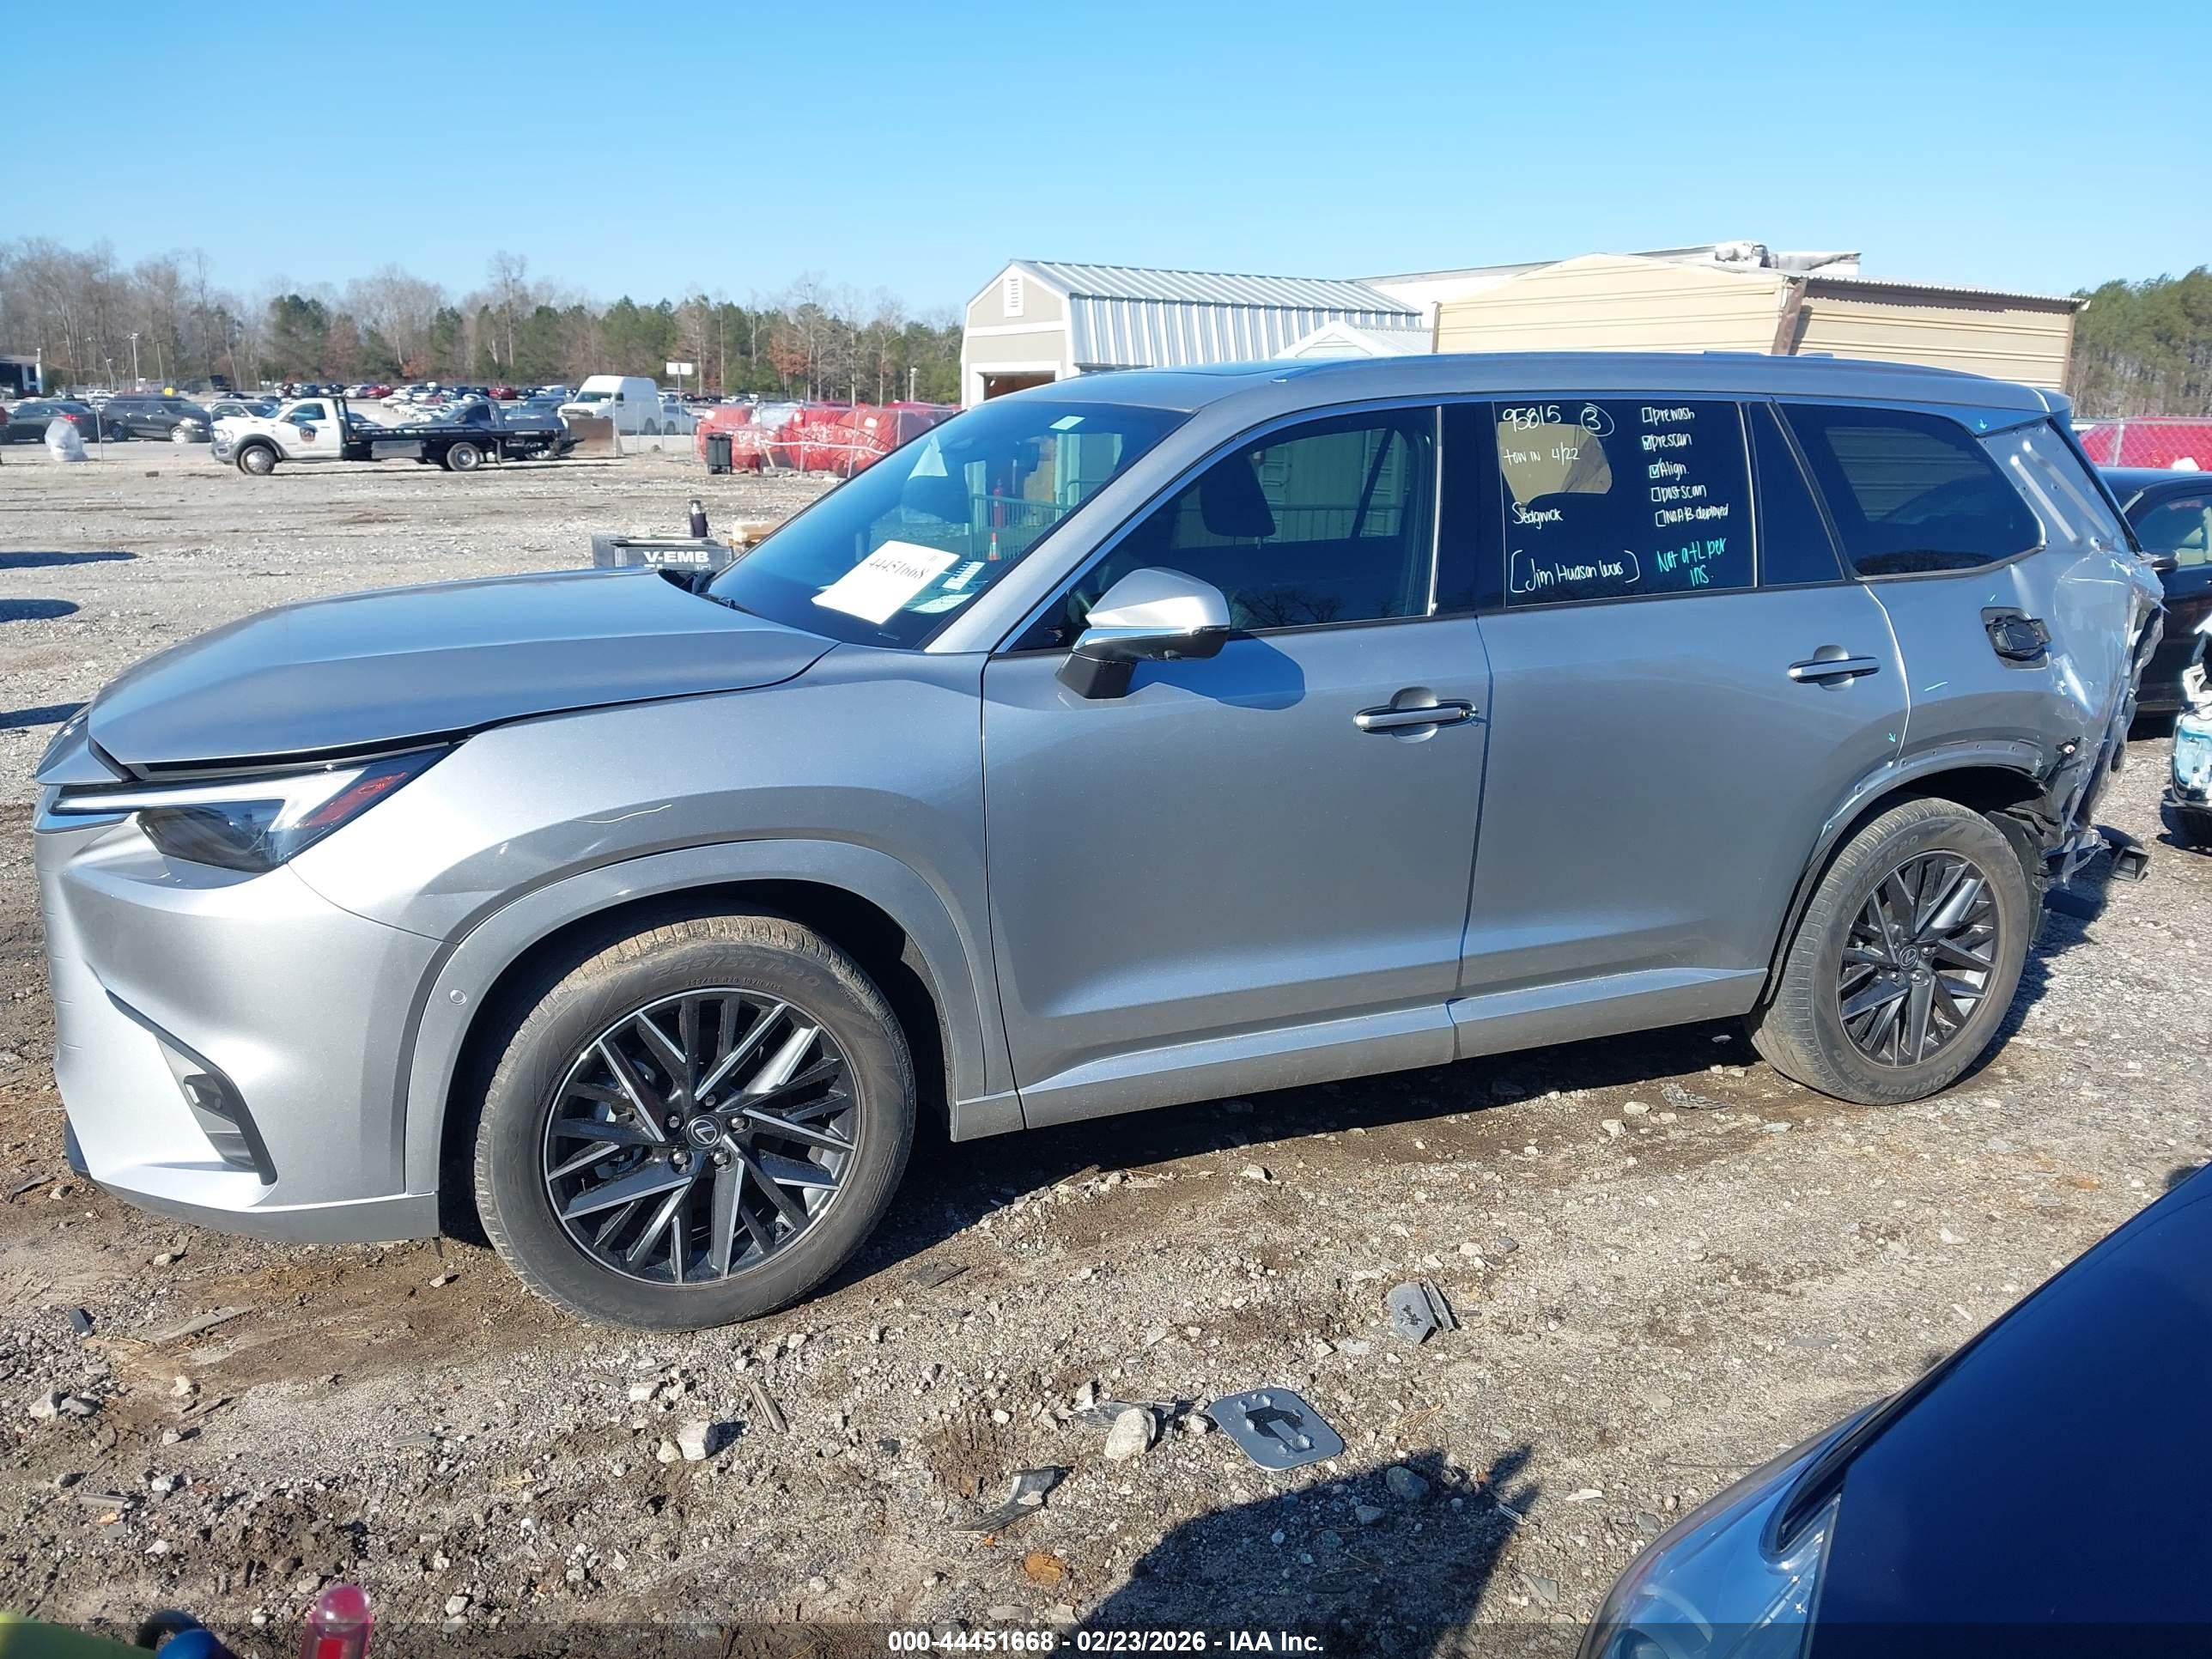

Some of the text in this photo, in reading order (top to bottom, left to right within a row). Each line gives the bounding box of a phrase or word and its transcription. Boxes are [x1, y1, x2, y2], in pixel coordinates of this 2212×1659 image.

[1503, 404, 1561, 432] 95815
[1552, 441, 1581, 465] 4/22
[642, 550, 709, 563] V-EMB
